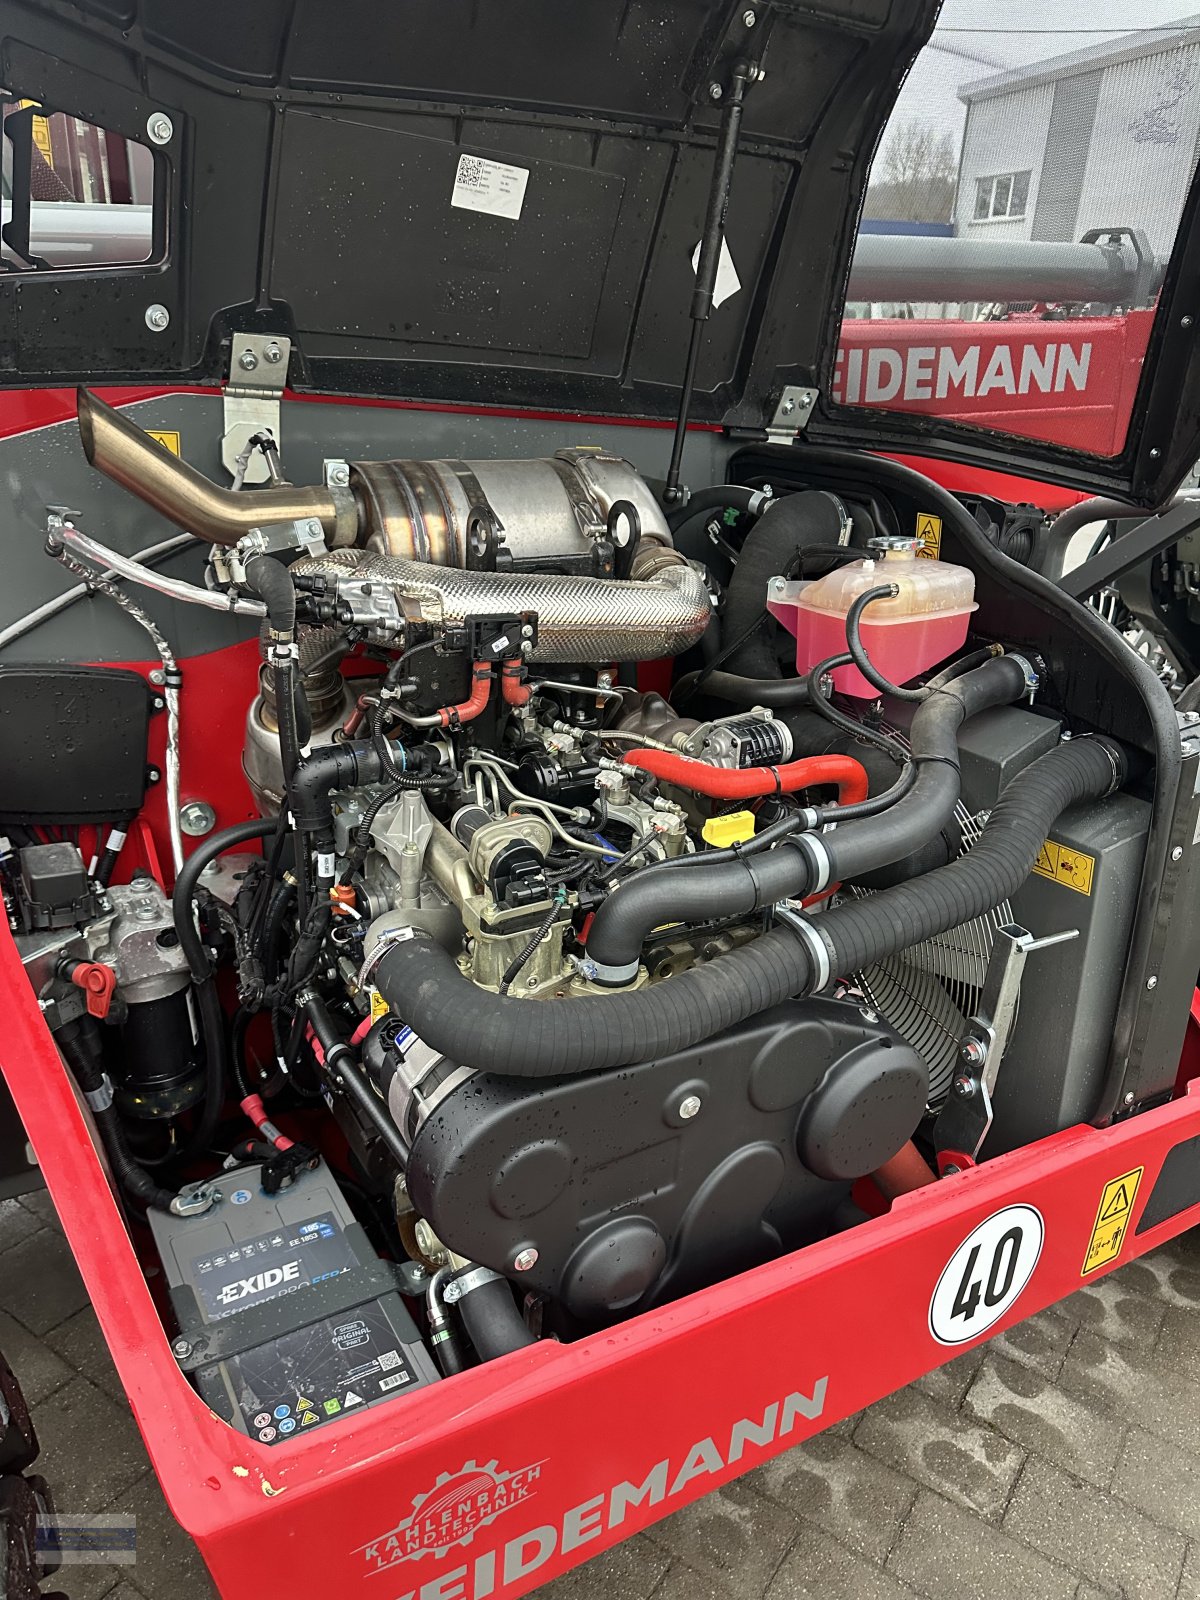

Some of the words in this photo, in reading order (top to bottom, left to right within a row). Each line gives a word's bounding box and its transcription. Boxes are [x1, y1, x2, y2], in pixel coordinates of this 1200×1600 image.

[216, 1261, 300, 1305] EXIDE
[950, 1226, 1024, 1322] 40
[331, 1327, 371, 1344] ORIGINAL
[345, 1338, 361, 1347] PART
[365, 1466, 541, 1561] KAHLENBACH
[377, 1485, 529, 1568] LANDTECHNIK
[395, 1376, 829, 1600] EIDEMANN
